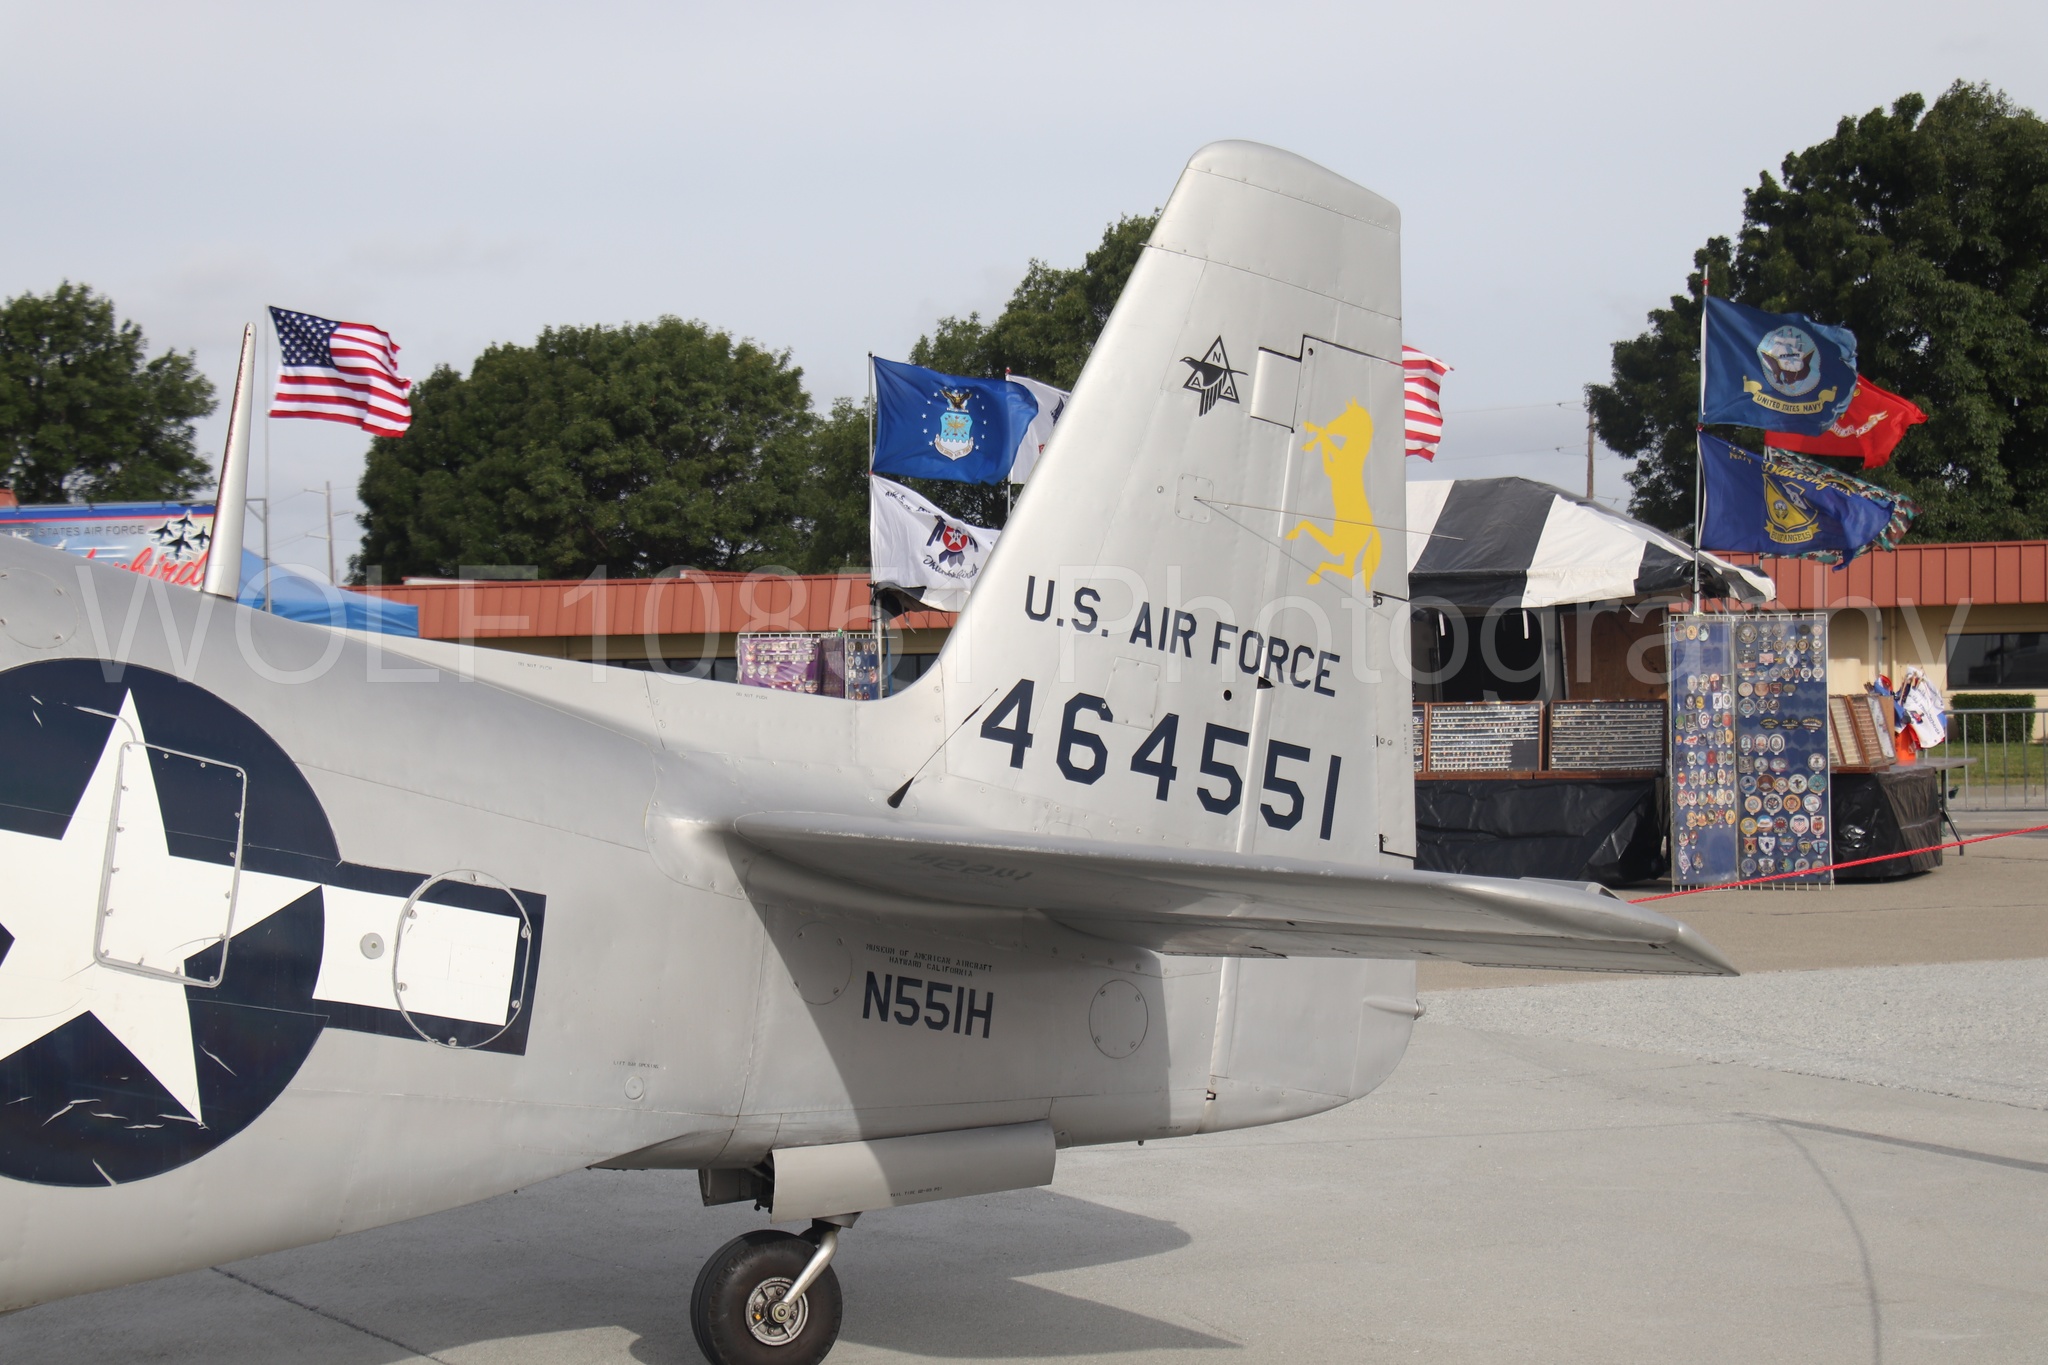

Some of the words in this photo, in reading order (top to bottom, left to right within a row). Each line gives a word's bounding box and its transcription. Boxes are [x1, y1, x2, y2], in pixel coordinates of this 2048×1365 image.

[1212, 351, 1221, 363] N
[1191, 376, 1201, 388] A
[1223, 385, 1234, 397] A
[1756, 394, 1780, 409] UNITED
[1781, 403, 1800, 412] STATES
[1803, 402, 1822, 412] NAVY
[38, 526, 80, 537] STATES
[84, 525, 103, 536] AIR
[105, 524, 145, 536] FORCE
[1024, 575, 1108, 638] U.S.
[1129, 601, 1197, 659] AIR
[1210, 620, 1341, 698] FORCE
[979, 678, 1342, 841] 464551
[866, 943, 895, 955] MUSEUM
[899, 949, 909, 957] OF
[914, 952, 951, 965] AMERICAN
[956, 960, 993, 973] AIRCRAFT
[889, 956, 922, 969] HAYWARD
[926, 963, 973, 977] CALIFORNIA
[862, 970, 994, 1039] N551H
